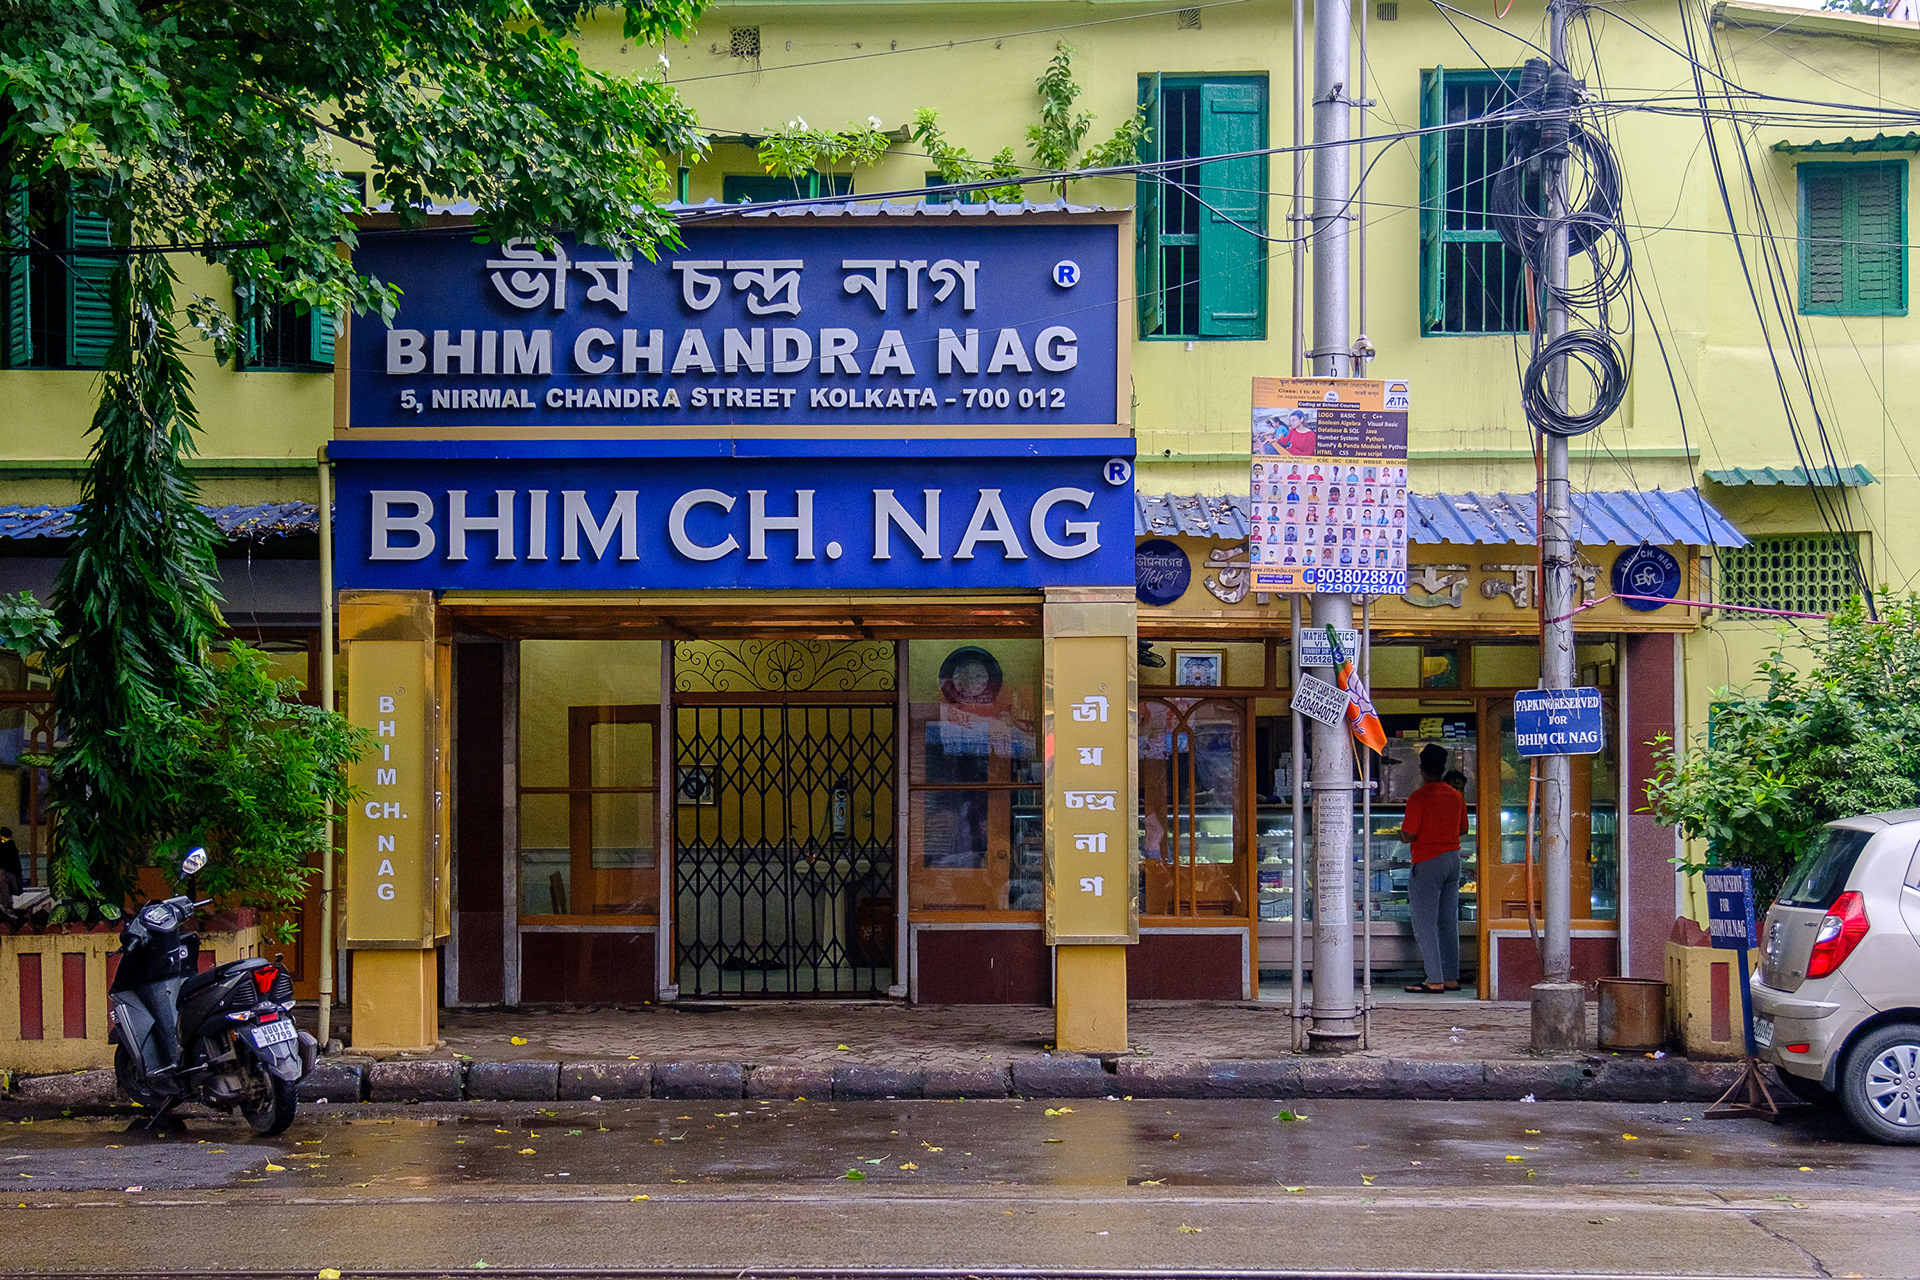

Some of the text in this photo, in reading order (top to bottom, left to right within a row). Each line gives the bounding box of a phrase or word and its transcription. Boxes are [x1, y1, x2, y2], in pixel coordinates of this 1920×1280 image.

[486, 236, 980, 318] ভীম চন্দ্র নাগ
[386, 325, 1079, 375] BHIM CHANDRA NAG
[401, 389, 424, 414] 5,
[432, 388, 537, 409] NIRMAL
[546, 388, 681, 409] CHANDRA
[691, 387, 796, 408] STREET
[811, 387, 937, 408] KOLKATA
[963, 388, 1010, 408] 700
[1018, 388, 1066, 408] 012
[369, 486, 1101, 562] BHIM CH. NAG
[1657, 554, 1673, 570] NAG
[1317, 568, 1405, 585] 9038028870
[1316, 583, 1406, 594] 6290736400
[1302, 688, 1342, 710] ON THE SPOT
[1516, 696, 1599, 712] PARKING RESERVED
[1296, 694, 1340, 724] 9304040072
[1548, 715, 1568, 725] FOR
[1518, 730, 1598, 746] BHIM CH. NAG
[365, 696, 408, 901] BHIM CH. NAG
[1720, 898, 1730, 912] FOR
